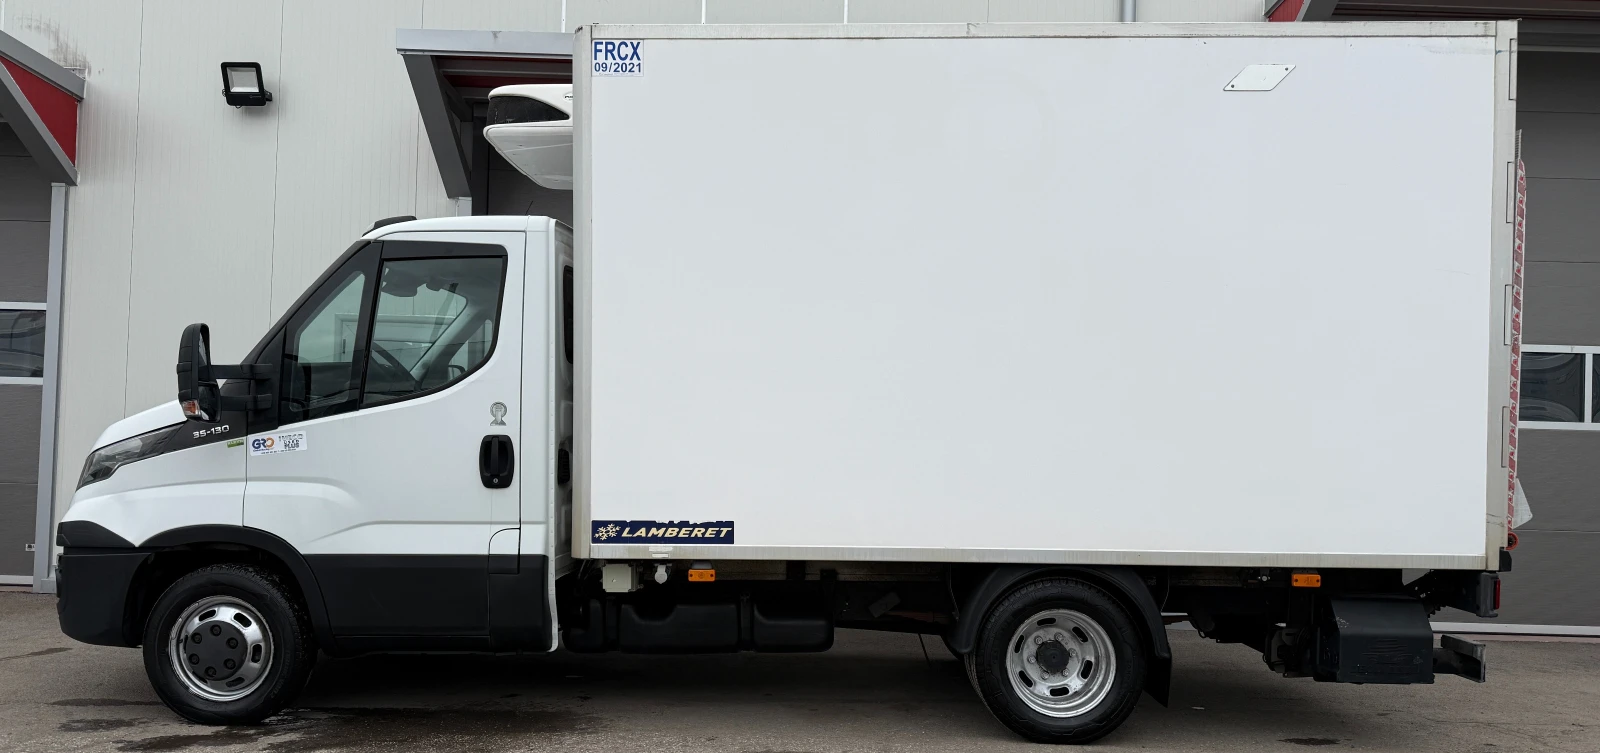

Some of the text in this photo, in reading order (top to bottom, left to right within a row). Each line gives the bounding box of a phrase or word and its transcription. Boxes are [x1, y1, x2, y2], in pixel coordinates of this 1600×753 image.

[594, 41, 641, 61] FRCX
[594, 62, 641, 73] 09/2021
[193, 425, 230, 438] 35-130
[252, 437, 275, 449] GRO
[621, 527, 732, 538] LAMBERET
